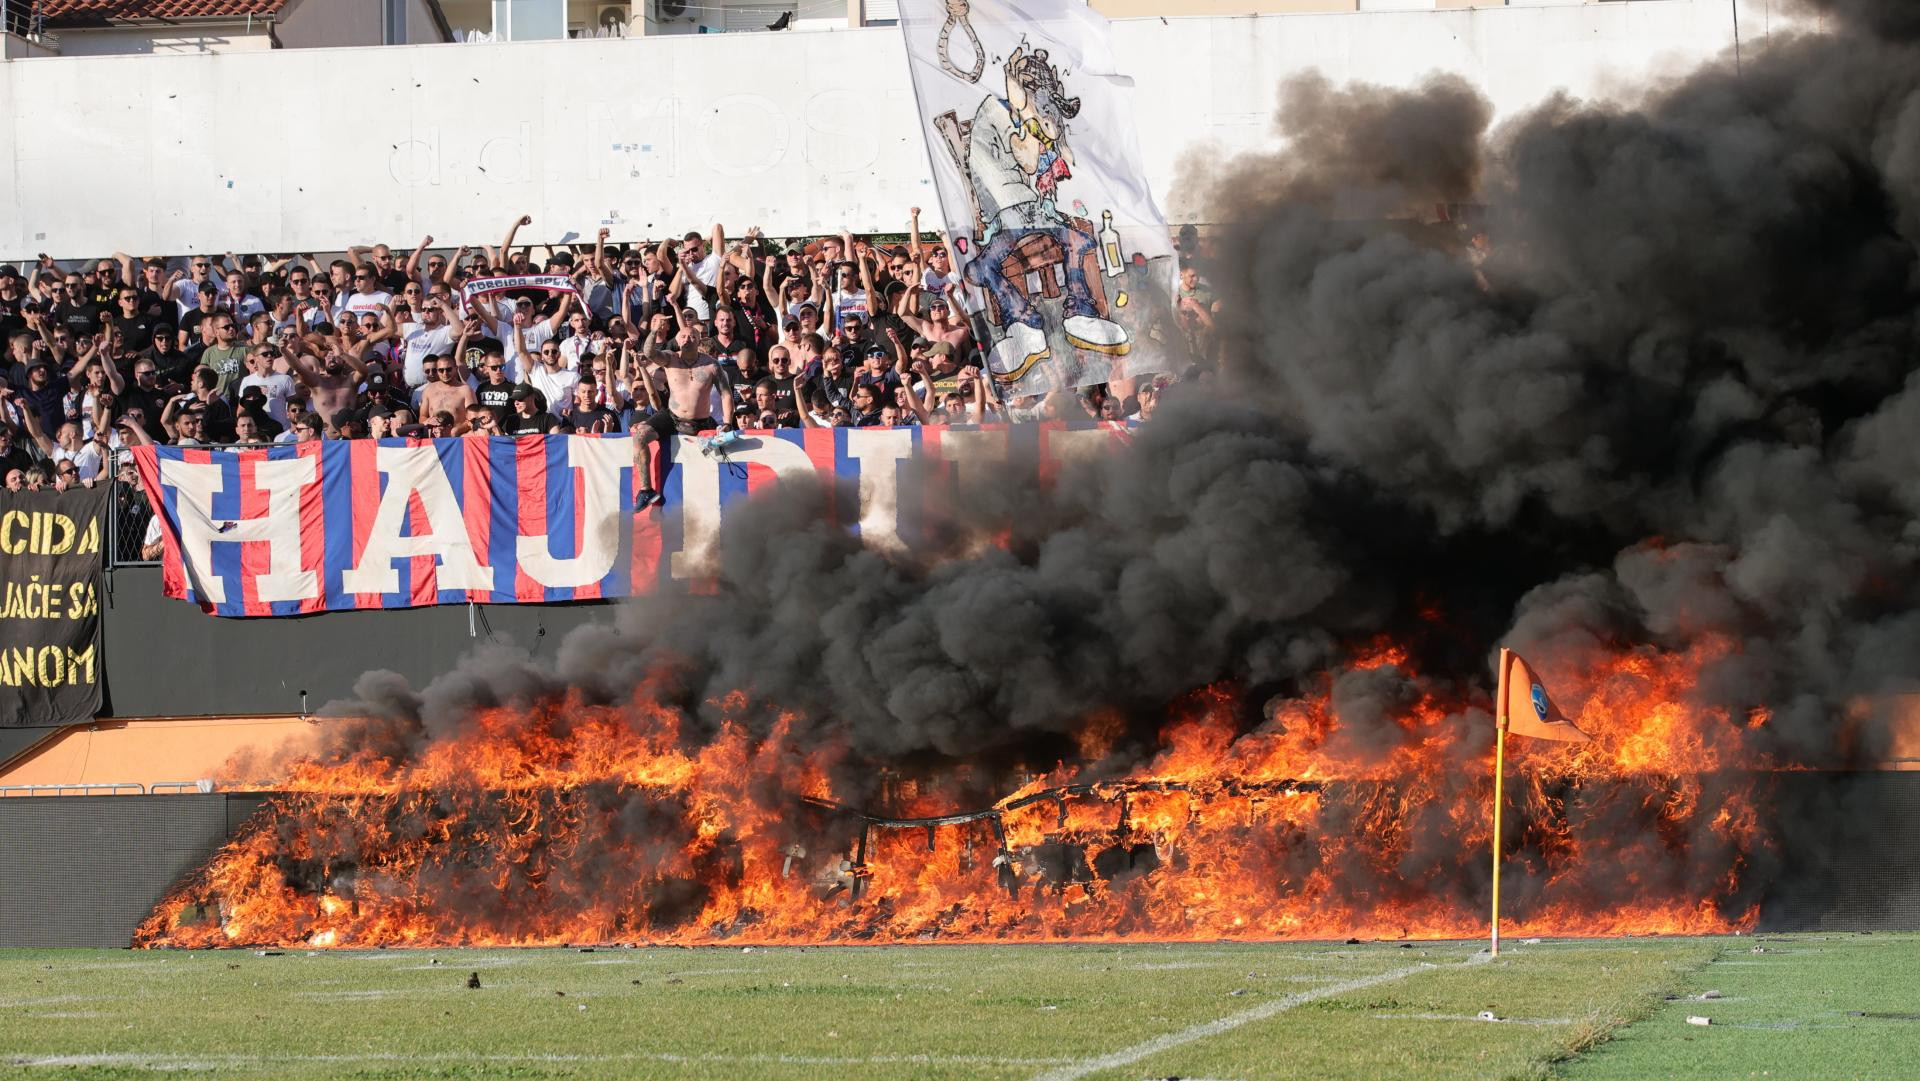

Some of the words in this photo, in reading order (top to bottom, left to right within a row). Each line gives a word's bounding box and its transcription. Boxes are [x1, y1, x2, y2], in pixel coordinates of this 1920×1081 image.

[584, 88, 913, 181] MOS
[467, 276, 528, 293] TORCIDA
[1, 510, 100, 555] CIDA
[158, 428, 1130, 606] HAJDU
[0, 574, 64, 620] JAČE
[67, 581, 99, 621] SA
